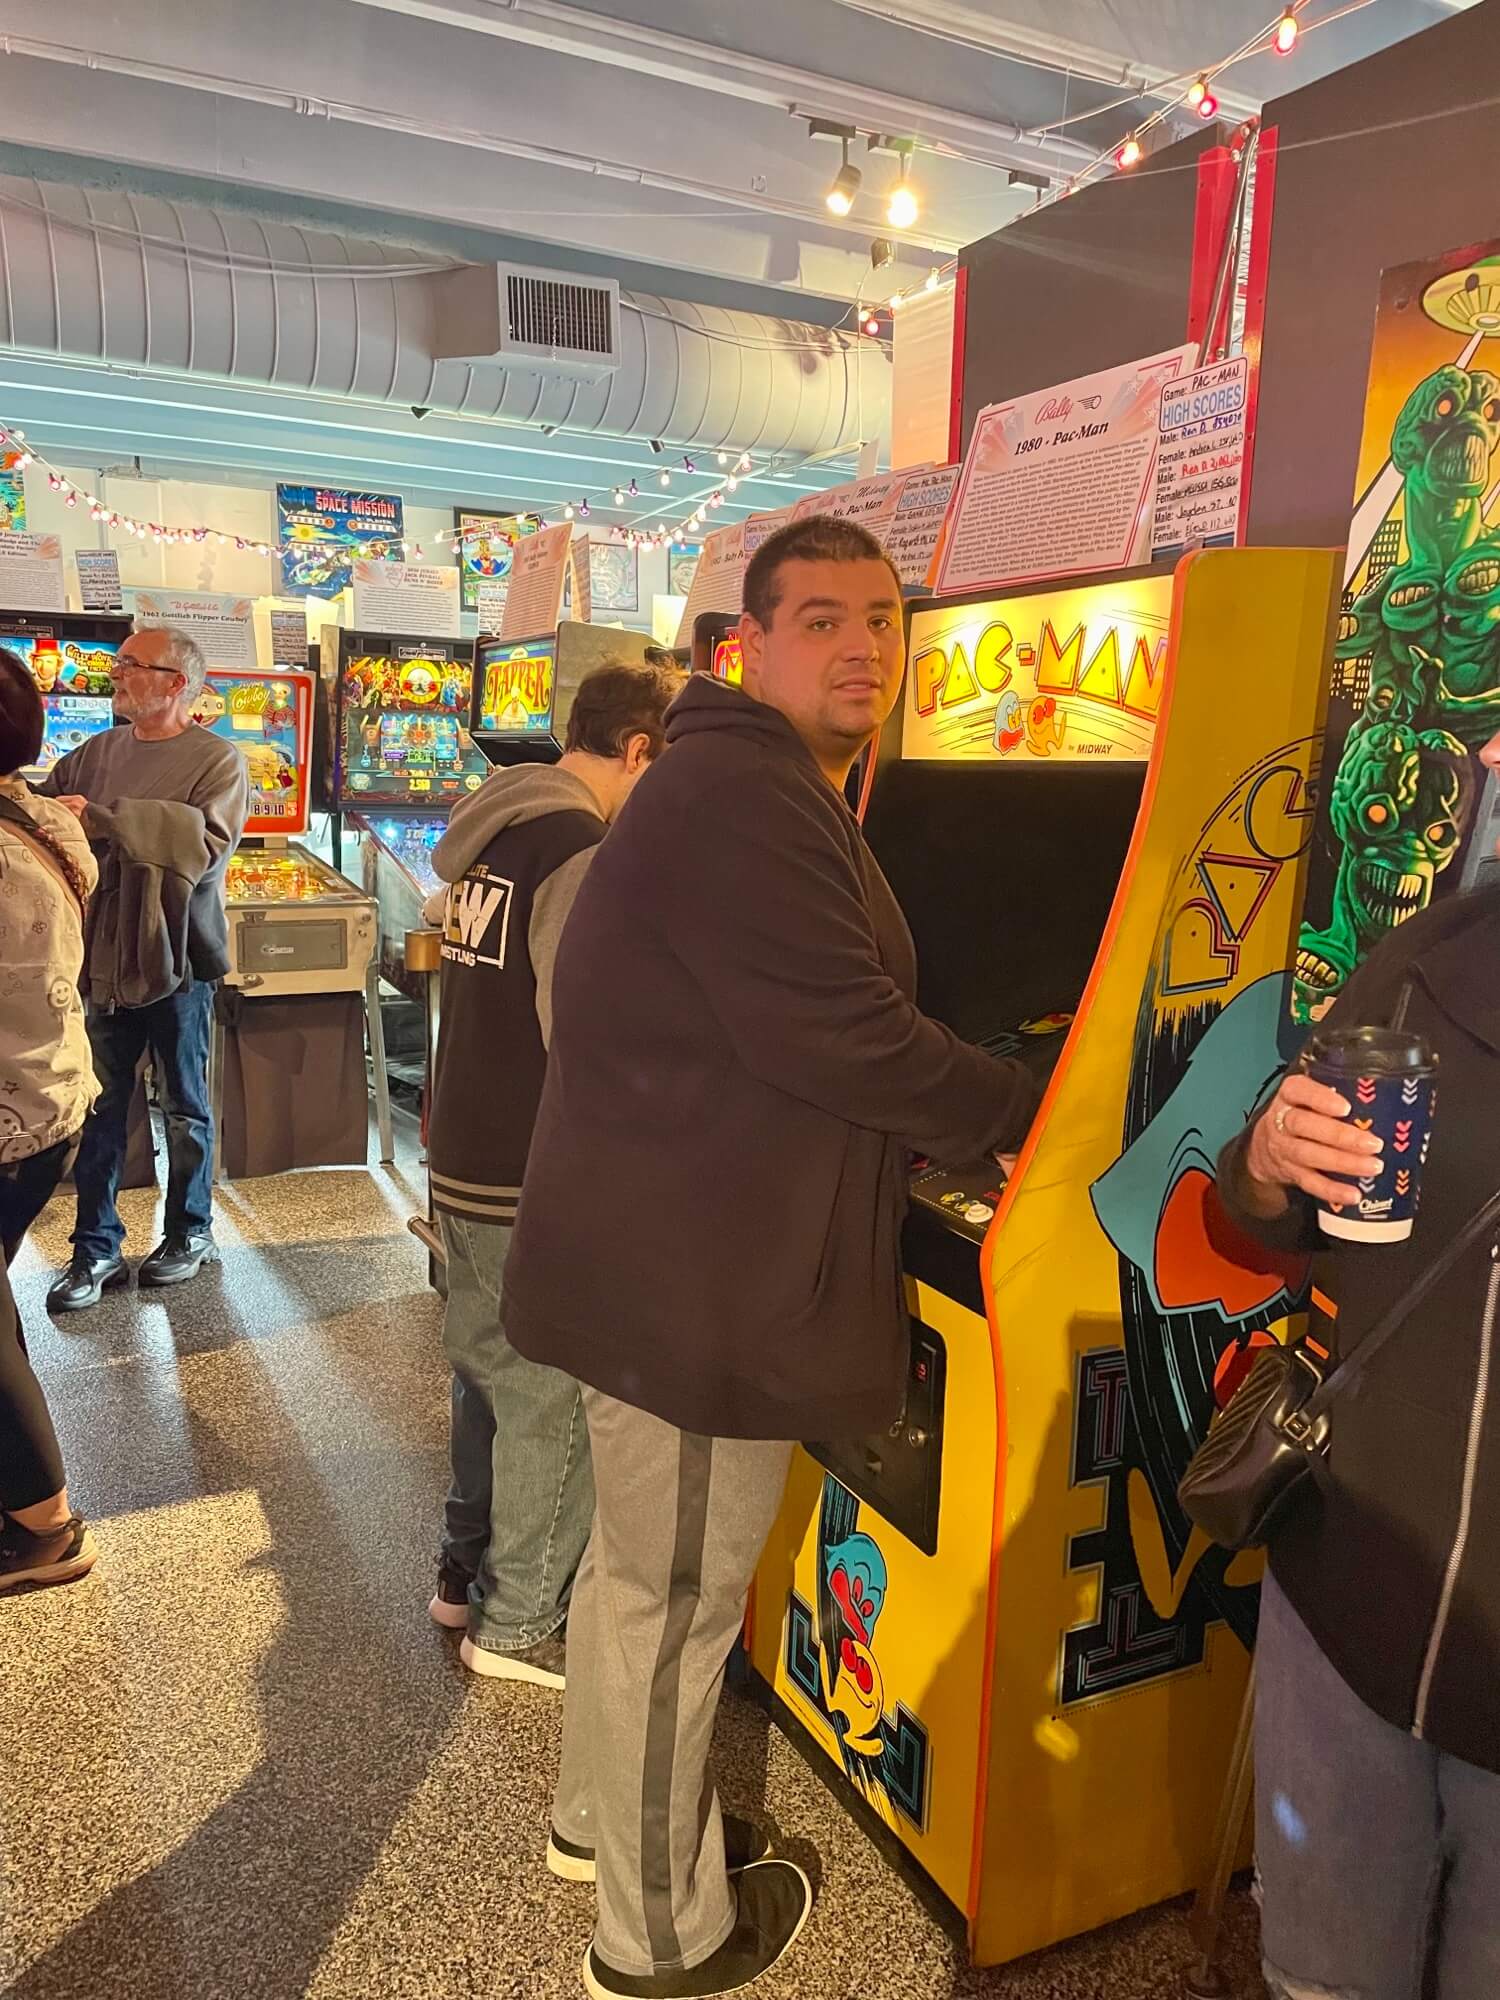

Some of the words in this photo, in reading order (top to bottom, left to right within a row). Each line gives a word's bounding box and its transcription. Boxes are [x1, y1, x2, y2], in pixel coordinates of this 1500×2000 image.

[1163, 387, 1187, 401] Game:
[1034, 396, 1075, 425] Bally
[1162, 400, 1190, 428] HIGH
[1193, 384, 1241, 418] SCORES
[1014, 436, 1043, 456] 1980
[1052, 421, 1110, 446] Pac-Man
[1158, 450, 1187, 465] Female:
[1157, 472, 1177, 485] Male:
[315, 495, 348, 513] SPACE
[351, 499, 396, 518] MISSION
[1154, 512, 1174, 524] Male:
[1153, 529, 1182, 544] Female:
[912, 618, 1169, 723] PAC-MAN
[487, 660, 550, 712] TAPPER
[232, 688, 271, 714] Cowboy
[1076, 744, 1113, 754] MIDWAY
[274, 804, 285, 816] 10
